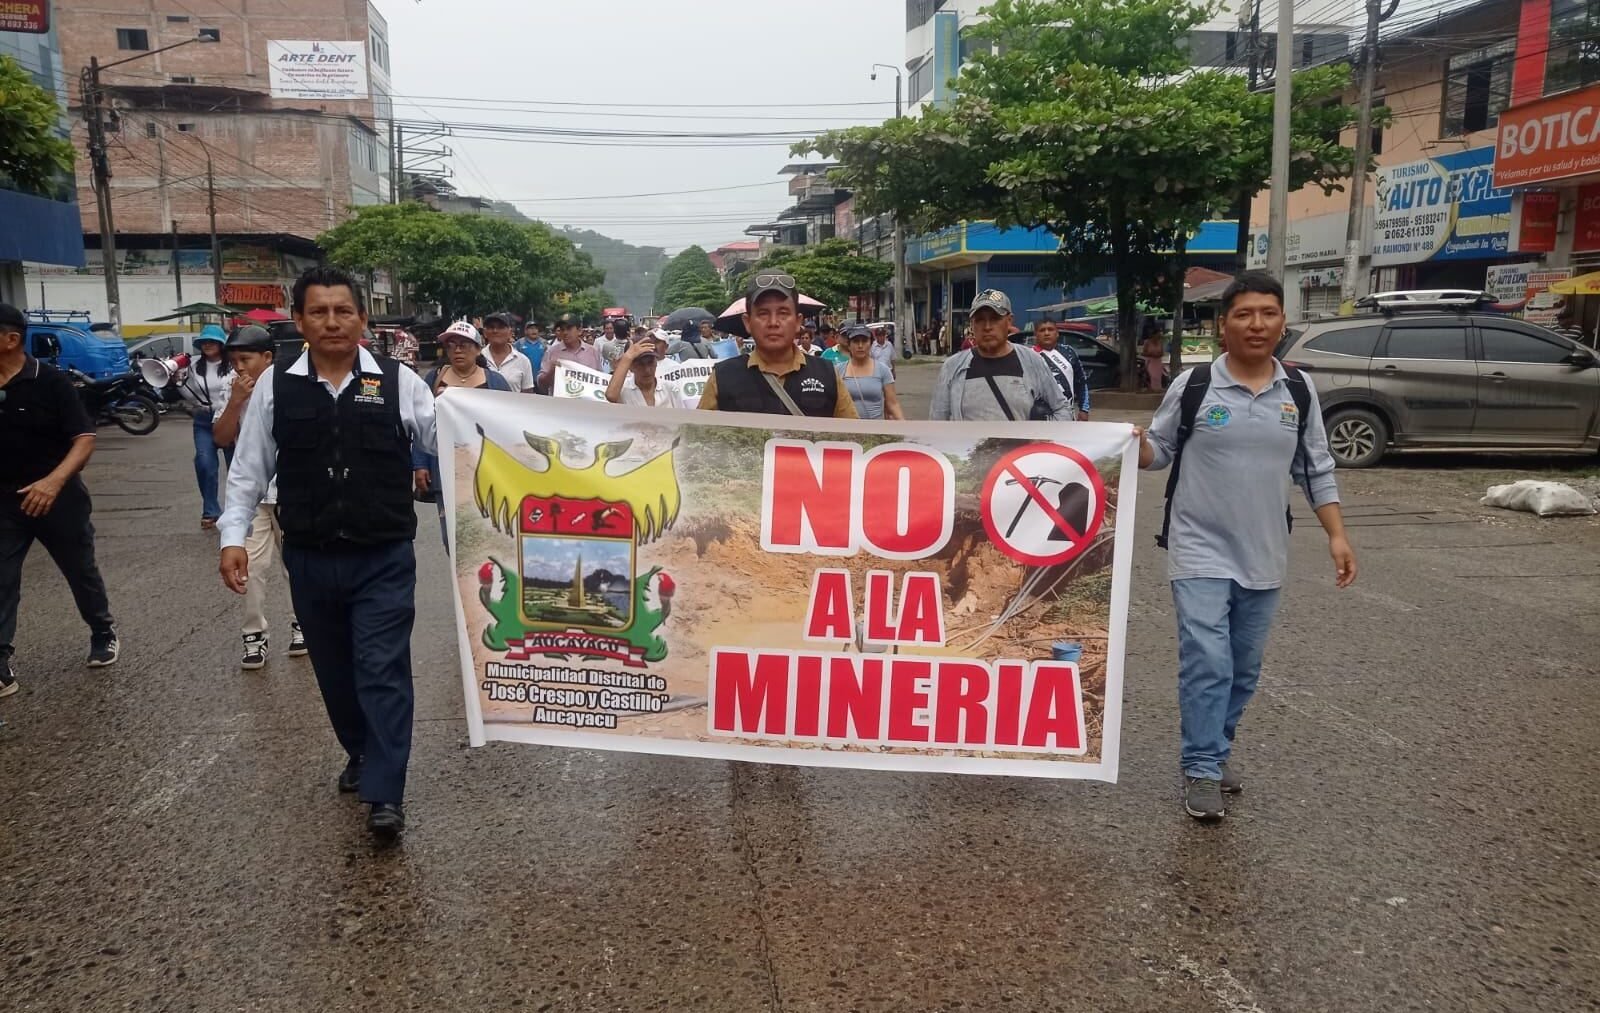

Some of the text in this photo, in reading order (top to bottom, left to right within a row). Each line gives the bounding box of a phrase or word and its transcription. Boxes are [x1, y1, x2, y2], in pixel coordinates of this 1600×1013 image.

[278, 53, 356, 63] ARTE DENT
[1392, 163, 1430, 179] TURISMO
[1529, 165, 1543, 177] por
[1544, 163, 1552, 172] tu
[1553, 158, 1574, 170] salud
[1574, 159, 1580, 170] y
[1388, 177, 1443, 212] AUTO
[1391, 225, 1435, 239] 062-611339
[564, 369, 600, 385] FRENTE
[768, 444, 948, 556] NO
[806, 571, 943, 644] A LA
[532, 634, 620, 652] AUCAYACU
[487, 663, 666, 691] Municipalidad Distrital de
[528, 685, 585, 707] Crespo
[586, 691, 597, 708] y
[712, 650, 1083, 751] MINERIA
[535, 707, 616, 729] Aucayacu
